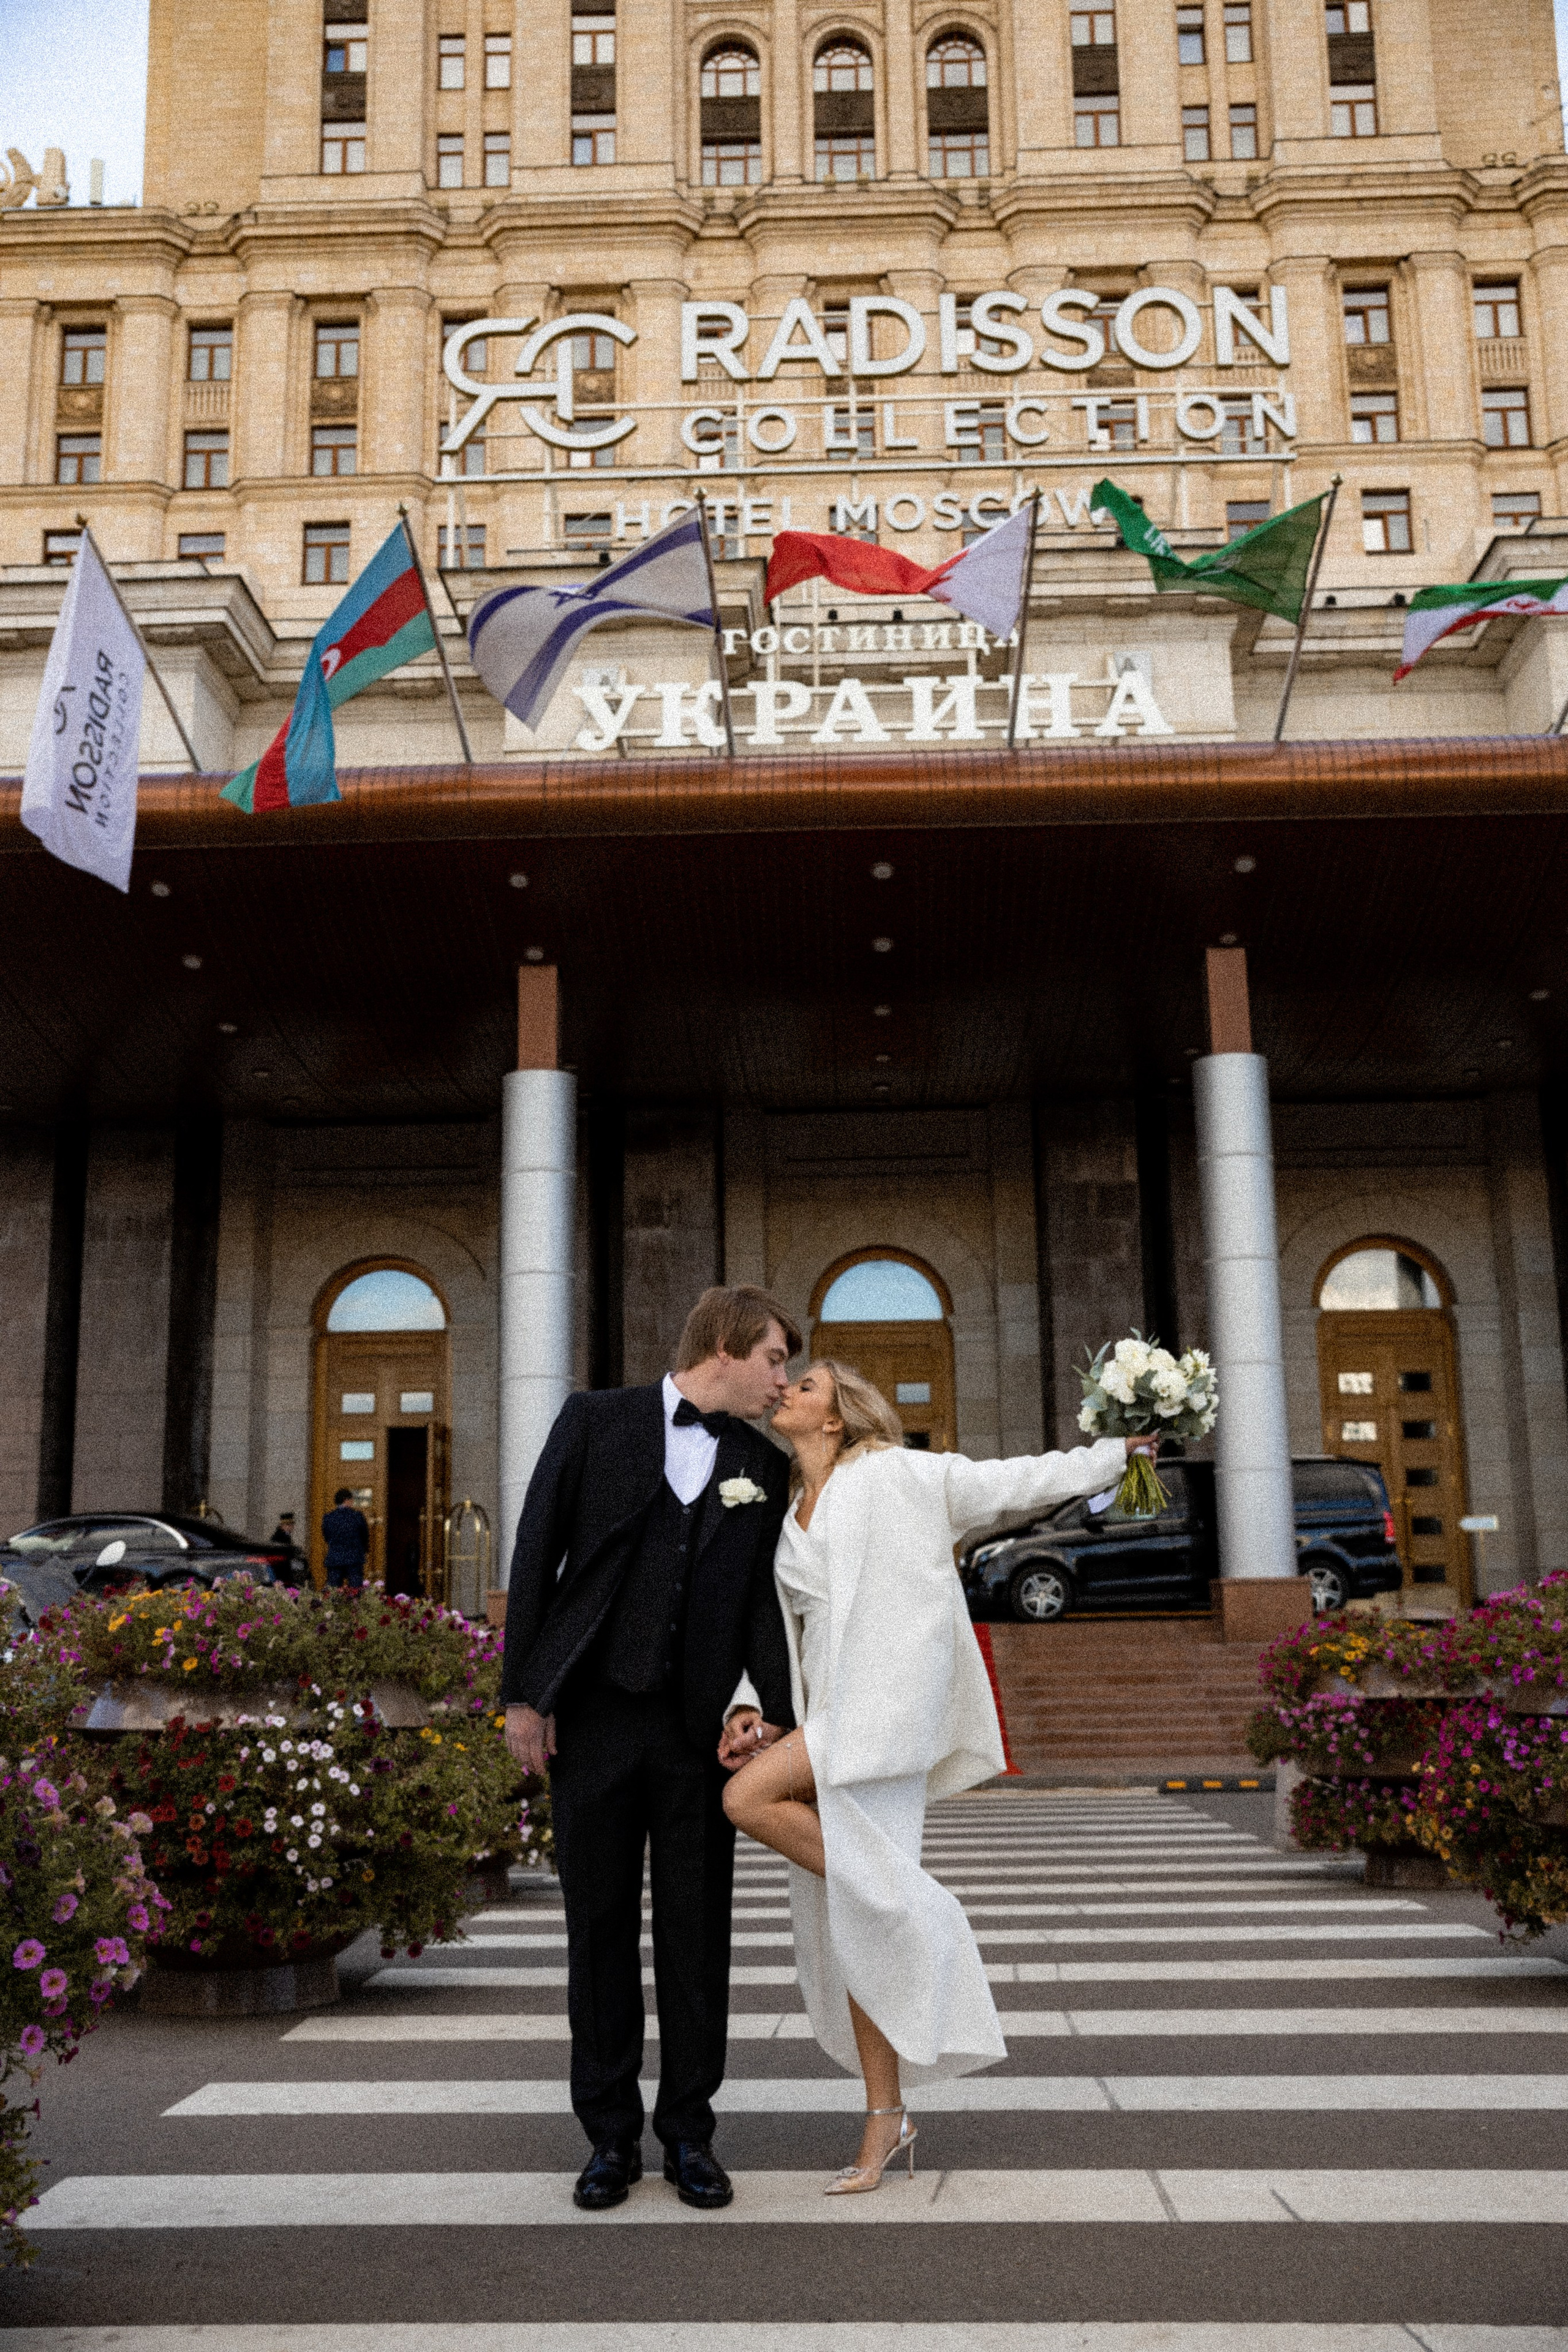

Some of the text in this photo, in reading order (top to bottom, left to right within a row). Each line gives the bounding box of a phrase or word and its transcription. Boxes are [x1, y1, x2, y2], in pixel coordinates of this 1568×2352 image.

[682, 285, 1290, 383] RADISSON
[680, 393, 1296, 454] COLLECTION
[617, 489, 1107, 539] HOTEL MOSCOW
[572, 671, 1174, 750] УКРАИНА
